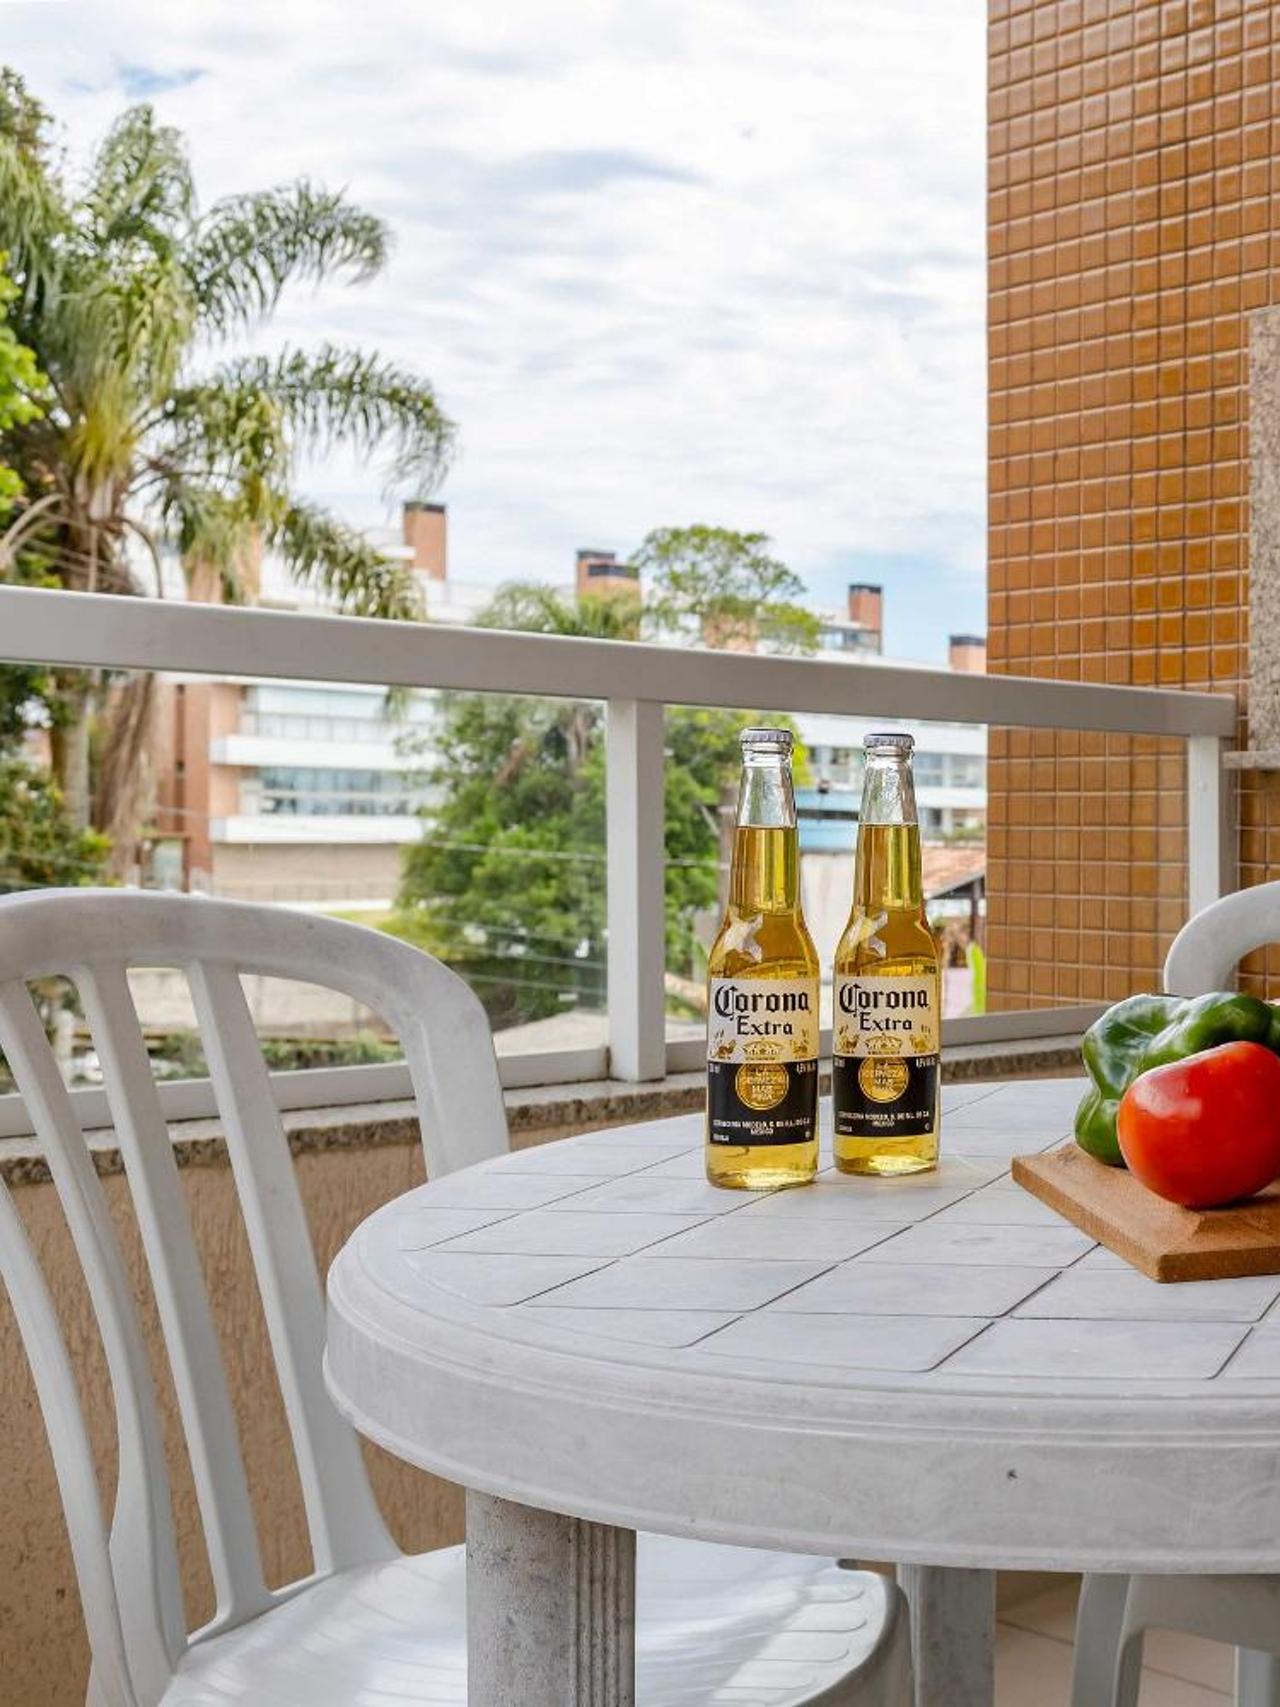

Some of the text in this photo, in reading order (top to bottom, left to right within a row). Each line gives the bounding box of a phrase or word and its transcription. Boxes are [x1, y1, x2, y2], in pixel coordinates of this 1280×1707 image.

[714, 985, 812, 1021] Corona
[838, 983, 931, 1018] Corona
[736, 1015, 793, 1035] Extra
[859, 1011, 912, 1031] Extra
